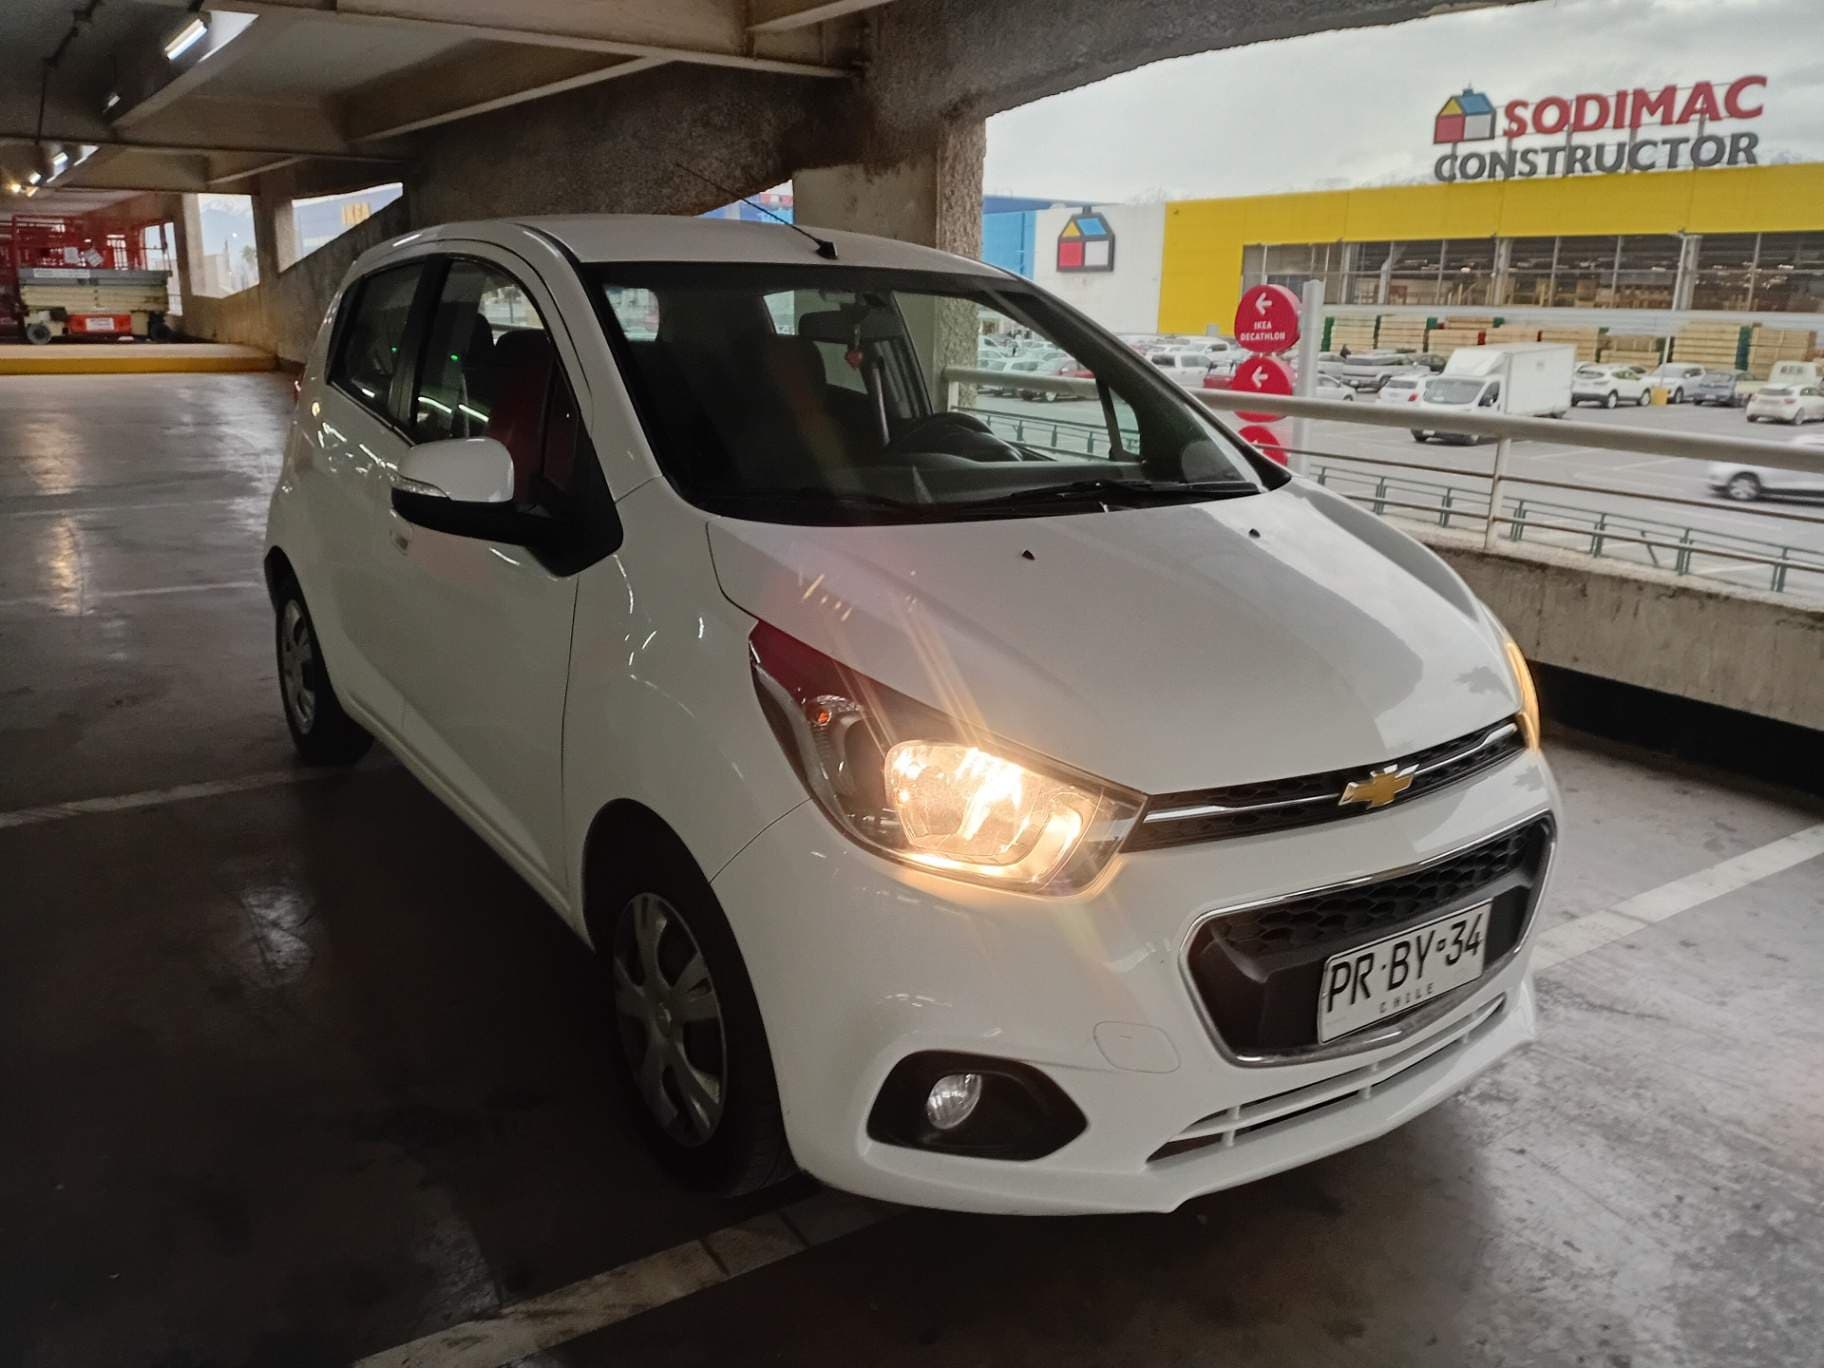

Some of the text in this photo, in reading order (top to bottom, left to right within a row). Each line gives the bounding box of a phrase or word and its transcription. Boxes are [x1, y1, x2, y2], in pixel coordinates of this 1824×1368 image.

[1503, 75, 1767, 138] SODIMAC
[1434, 132, 1758, 182] CONSTRUCTOR
[1240, 331, 1286, 342] DECATHLON
[1254, 320, 1272, 329] IKEA
[1379, 983, 1433, 1014] CHILE
